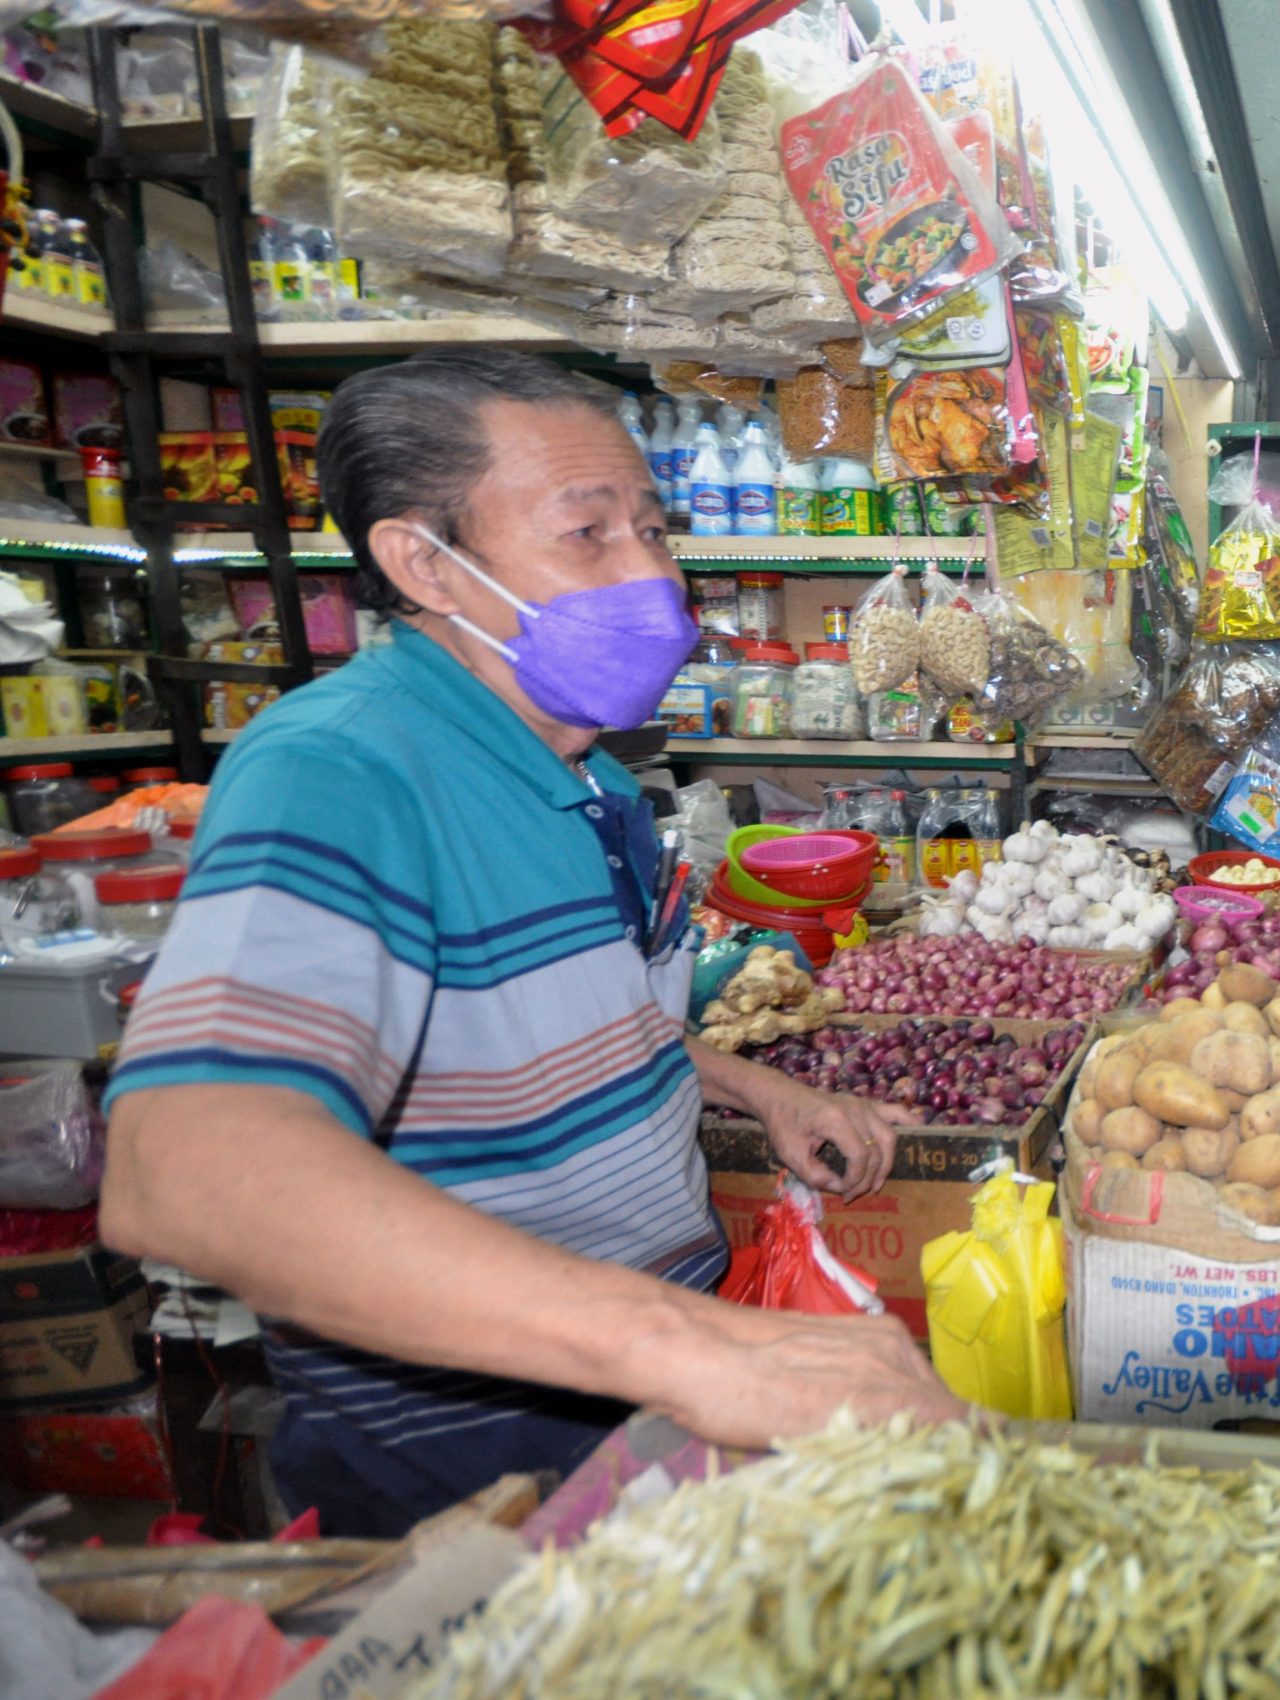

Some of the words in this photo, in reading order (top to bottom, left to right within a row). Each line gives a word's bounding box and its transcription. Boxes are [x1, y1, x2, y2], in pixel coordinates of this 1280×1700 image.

[827, 135, 890, 184] Rasa
[842, 160, 907, 219] Sifu
[904, 1145, 947, 1171] 1kg
[962, 1155, 978, 1167] 20
[1169, 1264, 1198, 1279] WT.
[1205, 1266, 1235, 1281] NET
[1241, 1268, 1277, 1283] LBS.
[1144, 1279, 1177, 1296] IDAHO
[1179, 1281, 1239, 1299] THORNTON,
[1254, 1287, 1276, 1301] INC.
[1102, 1350, 1214, 1414] Valley
[1216, 1373, 1269, 1405] the
